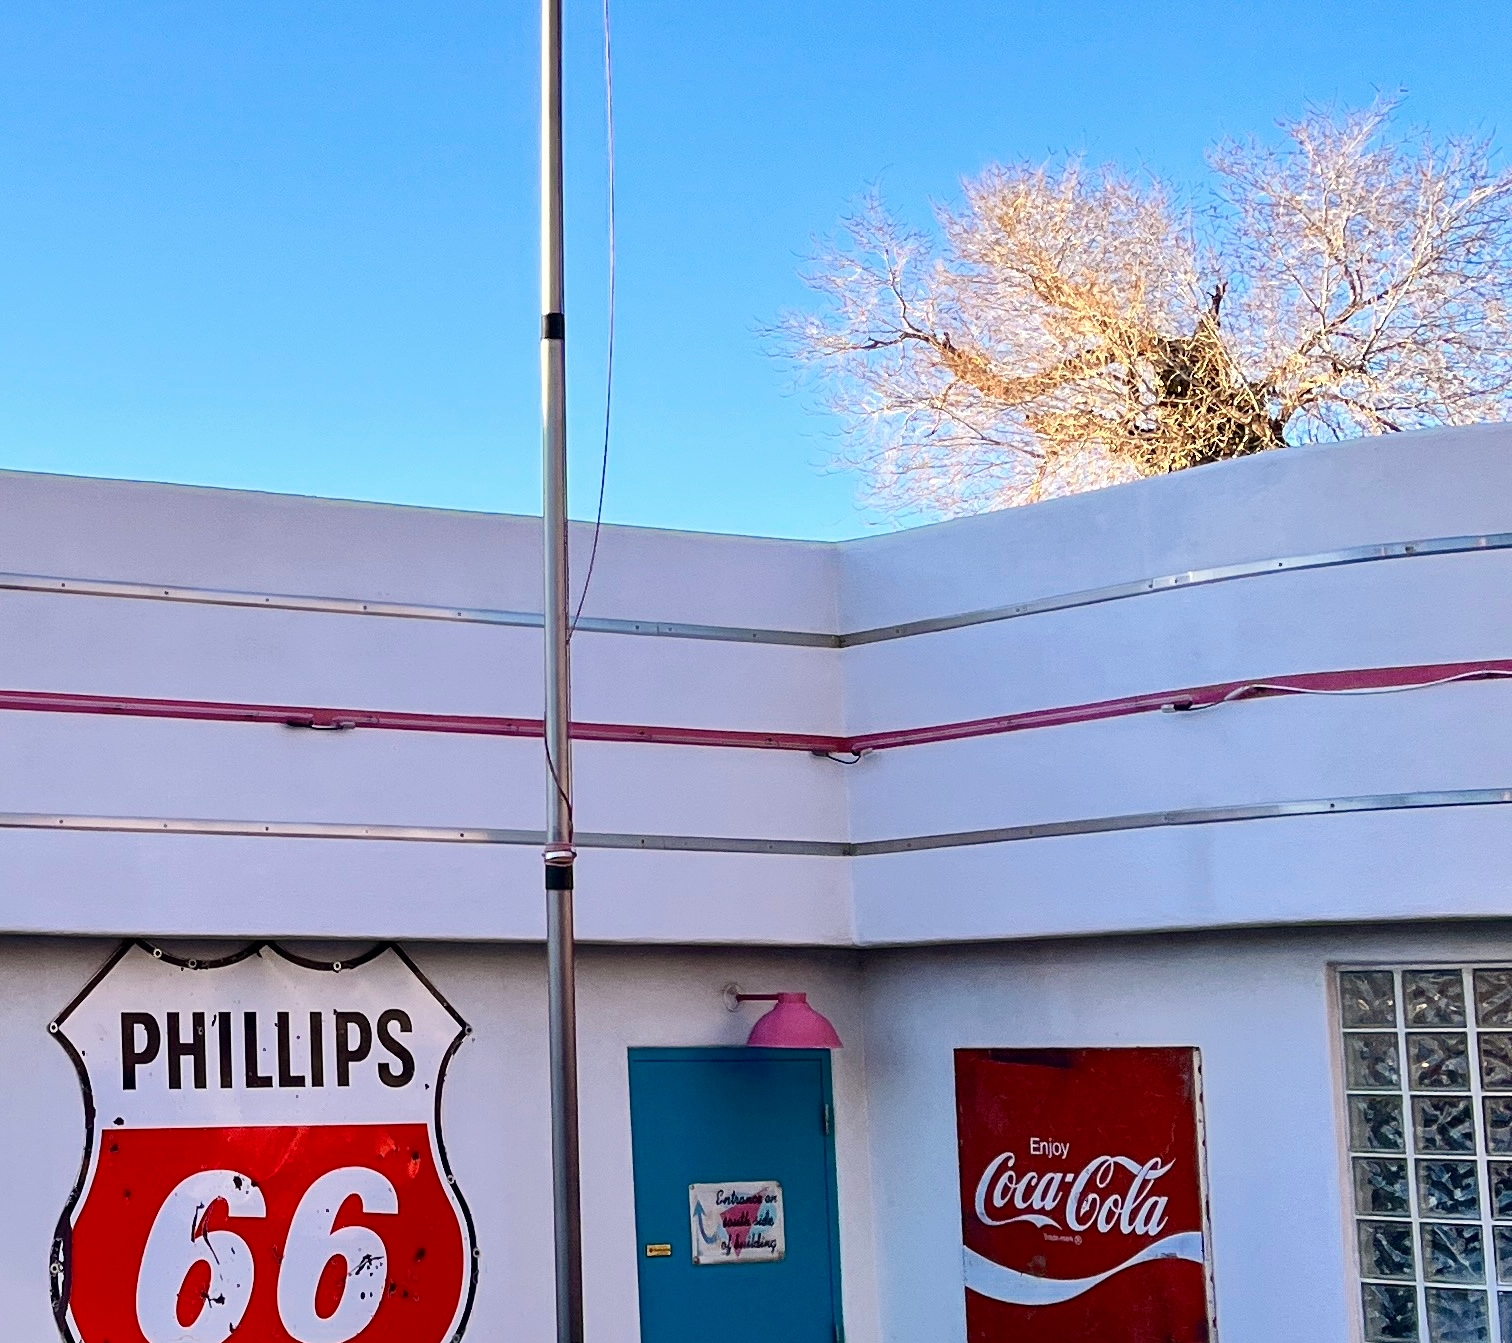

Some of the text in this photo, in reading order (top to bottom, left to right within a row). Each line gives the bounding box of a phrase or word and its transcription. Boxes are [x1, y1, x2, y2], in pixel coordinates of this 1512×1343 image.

[121, 1008, 416, 1091] PHILLIPS
[1030, 1137, 1070, 1159] Enjoy
[716, 1190, 777, 1205] Entrance on
[975, 1152, 1176, 1236] Coca-Cola
[723, 1210, 775, 1227] south side
[721, 1233, 777, 1256] of building
